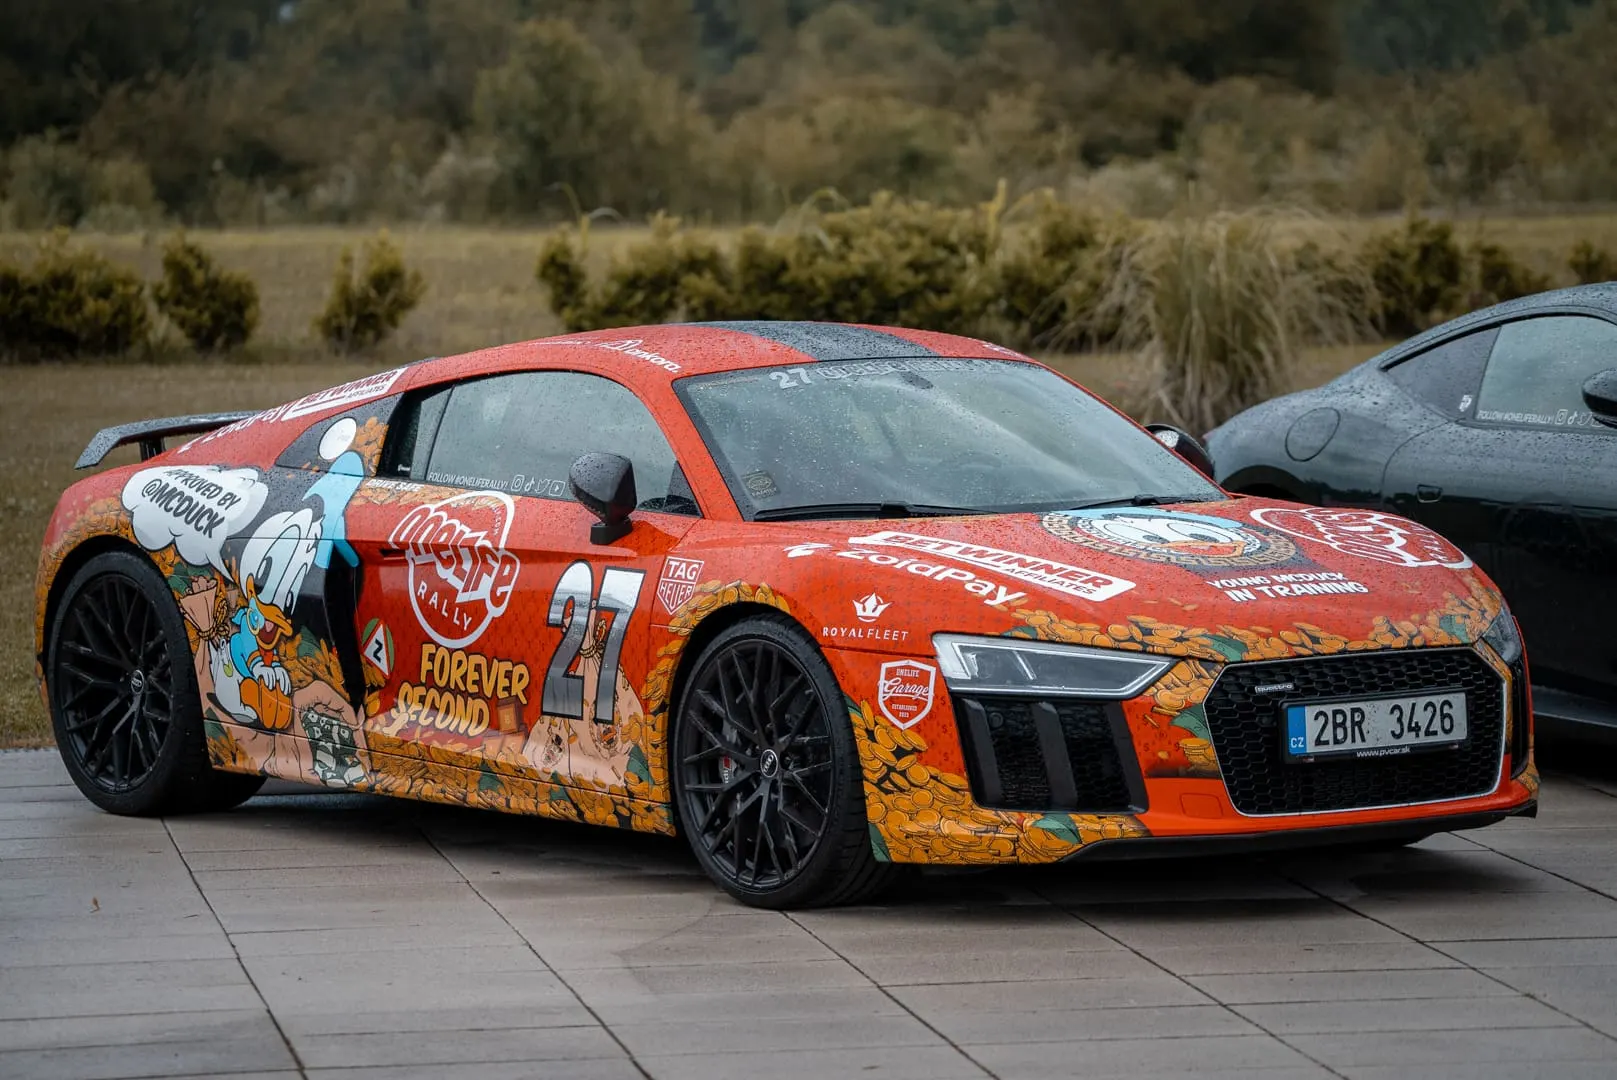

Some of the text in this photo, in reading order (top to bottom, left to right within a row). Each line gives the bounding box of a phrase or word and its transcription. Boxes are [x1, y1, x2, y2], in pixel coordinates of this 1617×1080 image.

[769, 369, 812, 389] 27
[164, 469, 241, 510] APPROVED BY
[365, 479, 425, 492] DRIVE SAFE
[428, 472, 456, 485] FOLLOW
[141, 478, 226, 539] @MCDUCK
[668, 560, 699, 580] TAG
[883, 534, 1114, 589] BETWINNER
[836, 547, 1028, 606] ZoidPay
[1002, 568, 1097, 595] AFFILIATES
[1206, 572, 1350, 590] YOUNG MCDUCK
[660, 582, 692, 610] HEUER
[1223, 581, 1369, 602] IN TRAINING
[417, 581, 473, 631] RALLY
[541, 559, 646, 724] 27
[420, 643, 530, 705] FOREVER
[878, 677, 934, 702] Garage
[391, 681, 490, 737] SECOND
[1313, 699, 1454, 747] 2BR 3426
[1290, 737, 1305, 749] CZ
[1356, 746, 1411, 759] www.pvcar.sk
